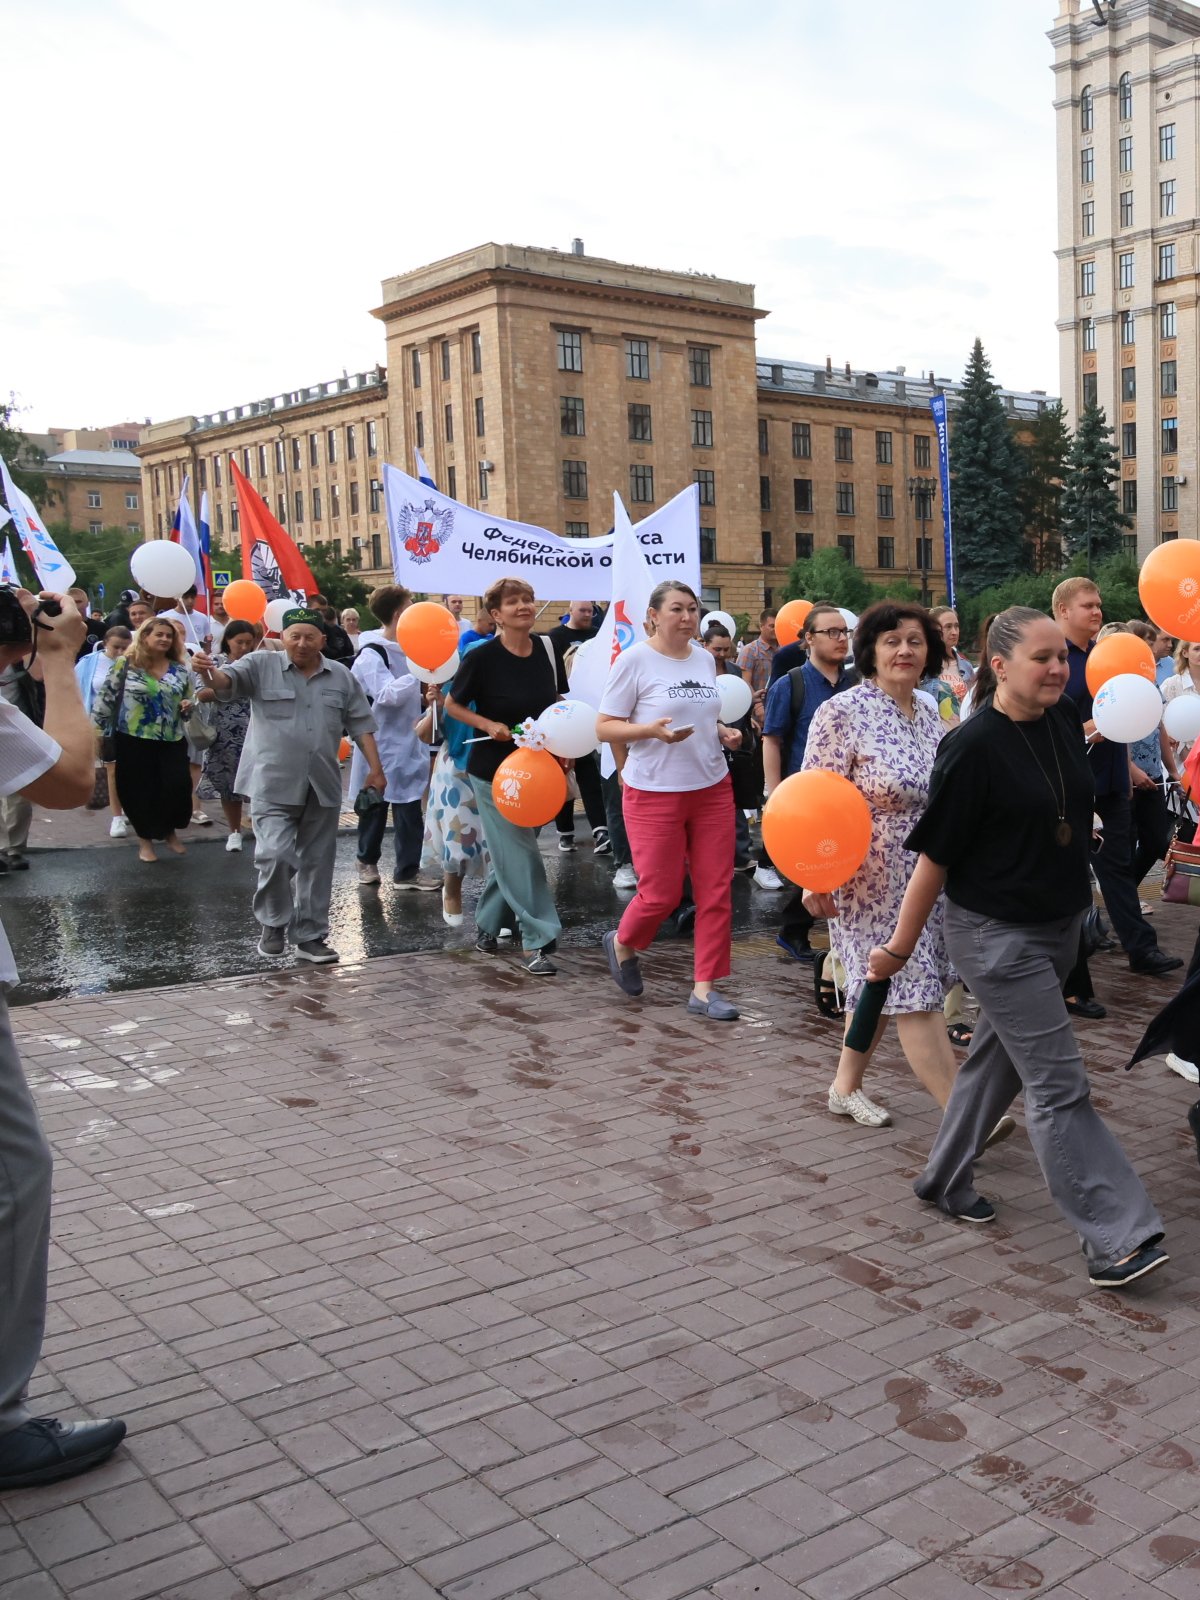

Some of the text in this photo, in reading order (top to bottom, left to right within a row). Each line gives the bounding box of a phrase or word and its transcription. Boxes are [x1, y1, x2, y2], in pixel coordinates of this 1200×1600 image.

[461, 541, 685, 568] Челябинской оасти
[499, 766, 532, 780] СЕМЬИ
